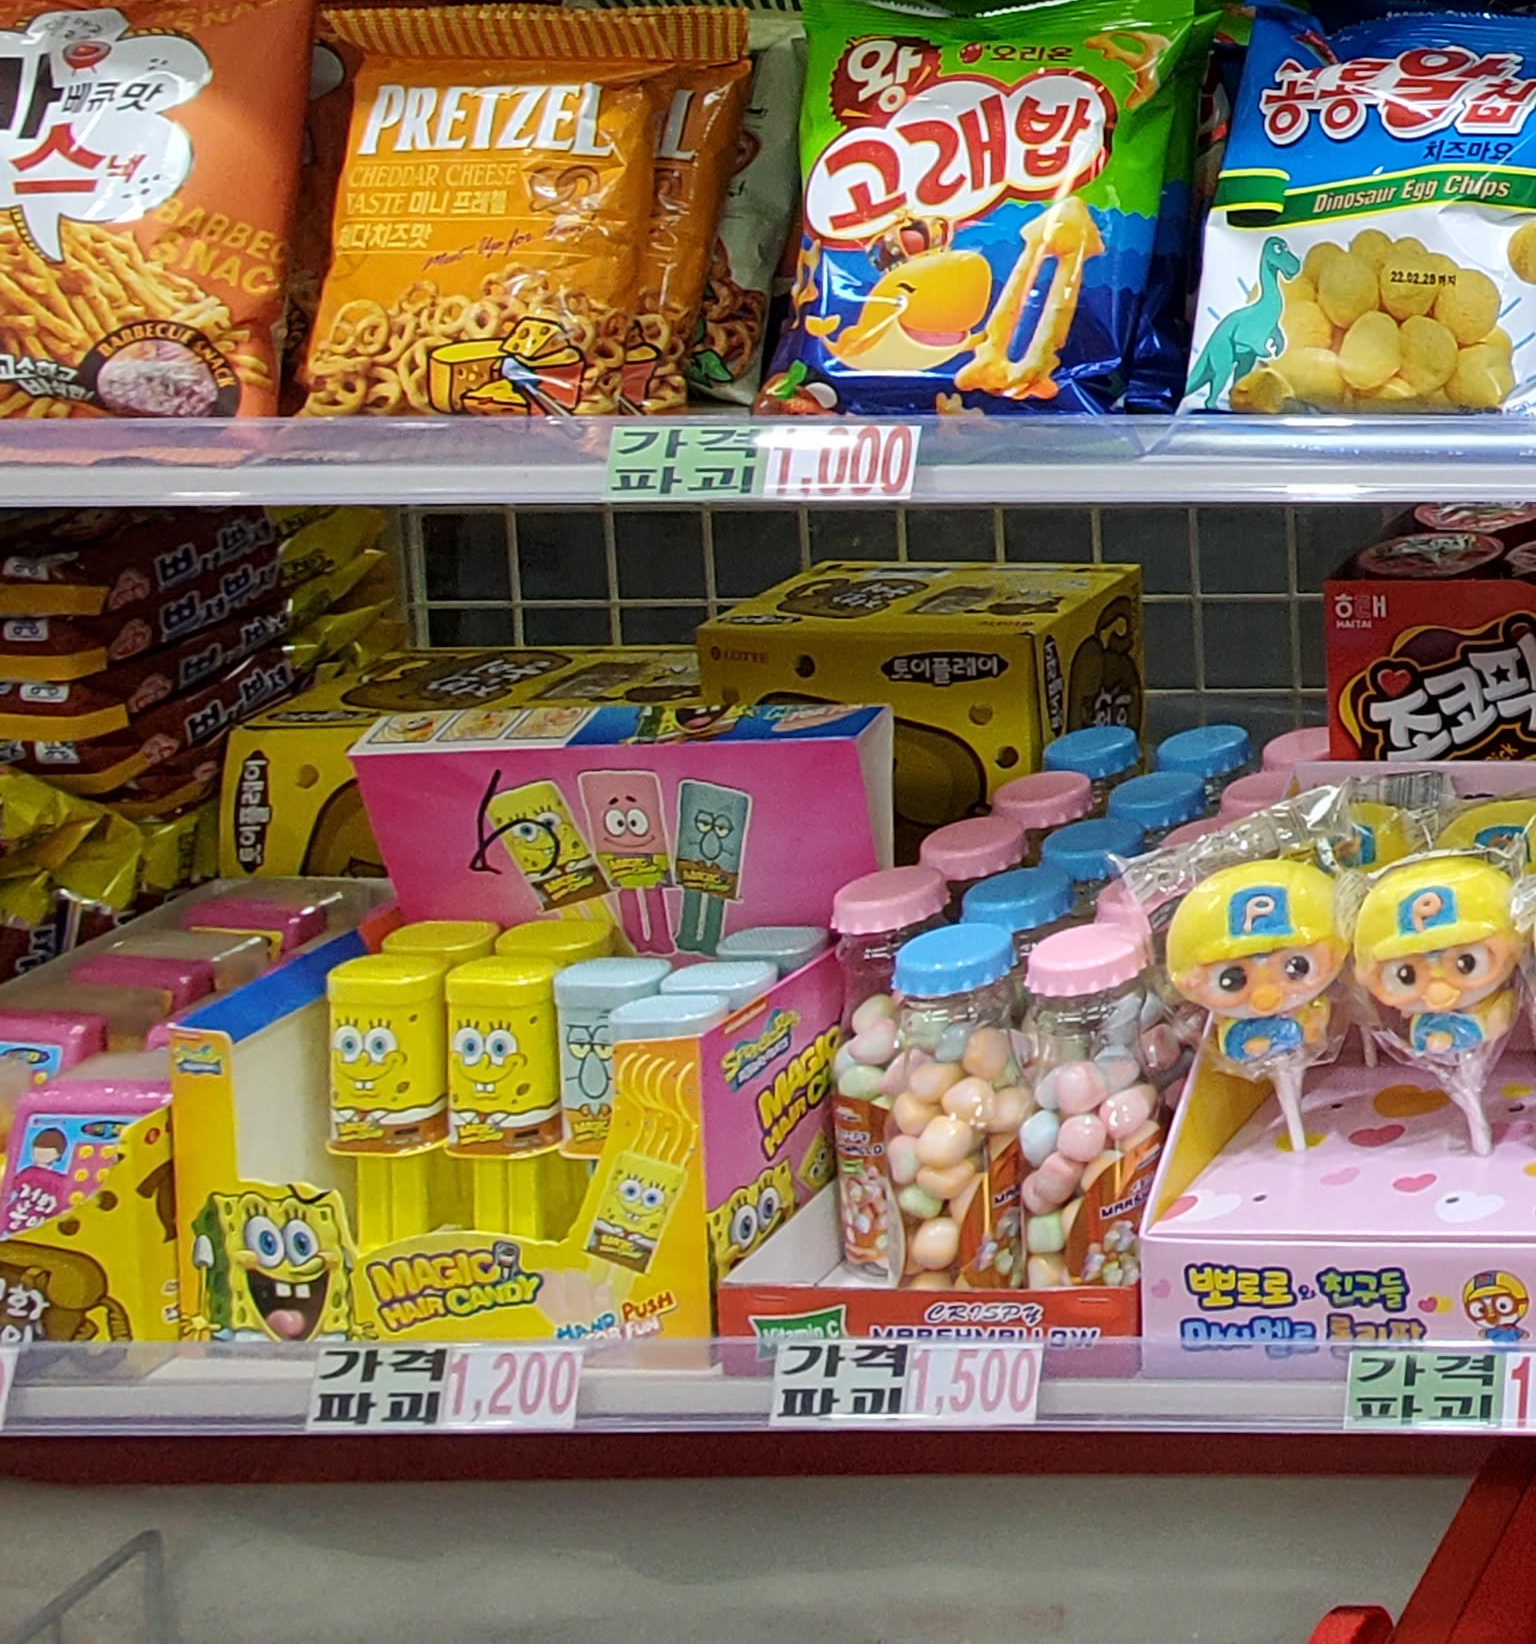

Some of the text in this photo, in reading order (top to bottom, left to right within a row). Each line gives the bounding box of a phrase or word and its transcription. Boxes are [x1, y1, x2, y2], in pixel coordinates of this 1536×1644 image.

[991, 44, 1074, 64] 오리온
[847, 41, 924, 114] 왕
[358, 82, 616, 156] PRETZEL
[823, 94, 1101, 230] 고래밥
[1422, 140, 1514, 162] 치즈마요
[350, 163, 519, 187] CHEDDAR CHEESE
[346, 191, 450, 215] TASTE 미니
[1313, 175, 1510, 214] Dinosaur Egg Chips
[1336, 620, 1372, 629] HAITAI
[892, 656, 1000, 685] 토이플레이
[1243, 896, 1275, 933] P
[369, 1252, 502, 1302] MAGIC
[1185, 1264, 1410, 1312] 뽀로로 친구들
[381, 1275, 541, 1329] HAIR CANDY
[621, 1292, 675, 1321] PUSH
[924, 1303, 1044, 1325] CRISPY
[449, 1352, 577, 1416] 1,200
[910, 1348, 1038, 1415] 1,500
